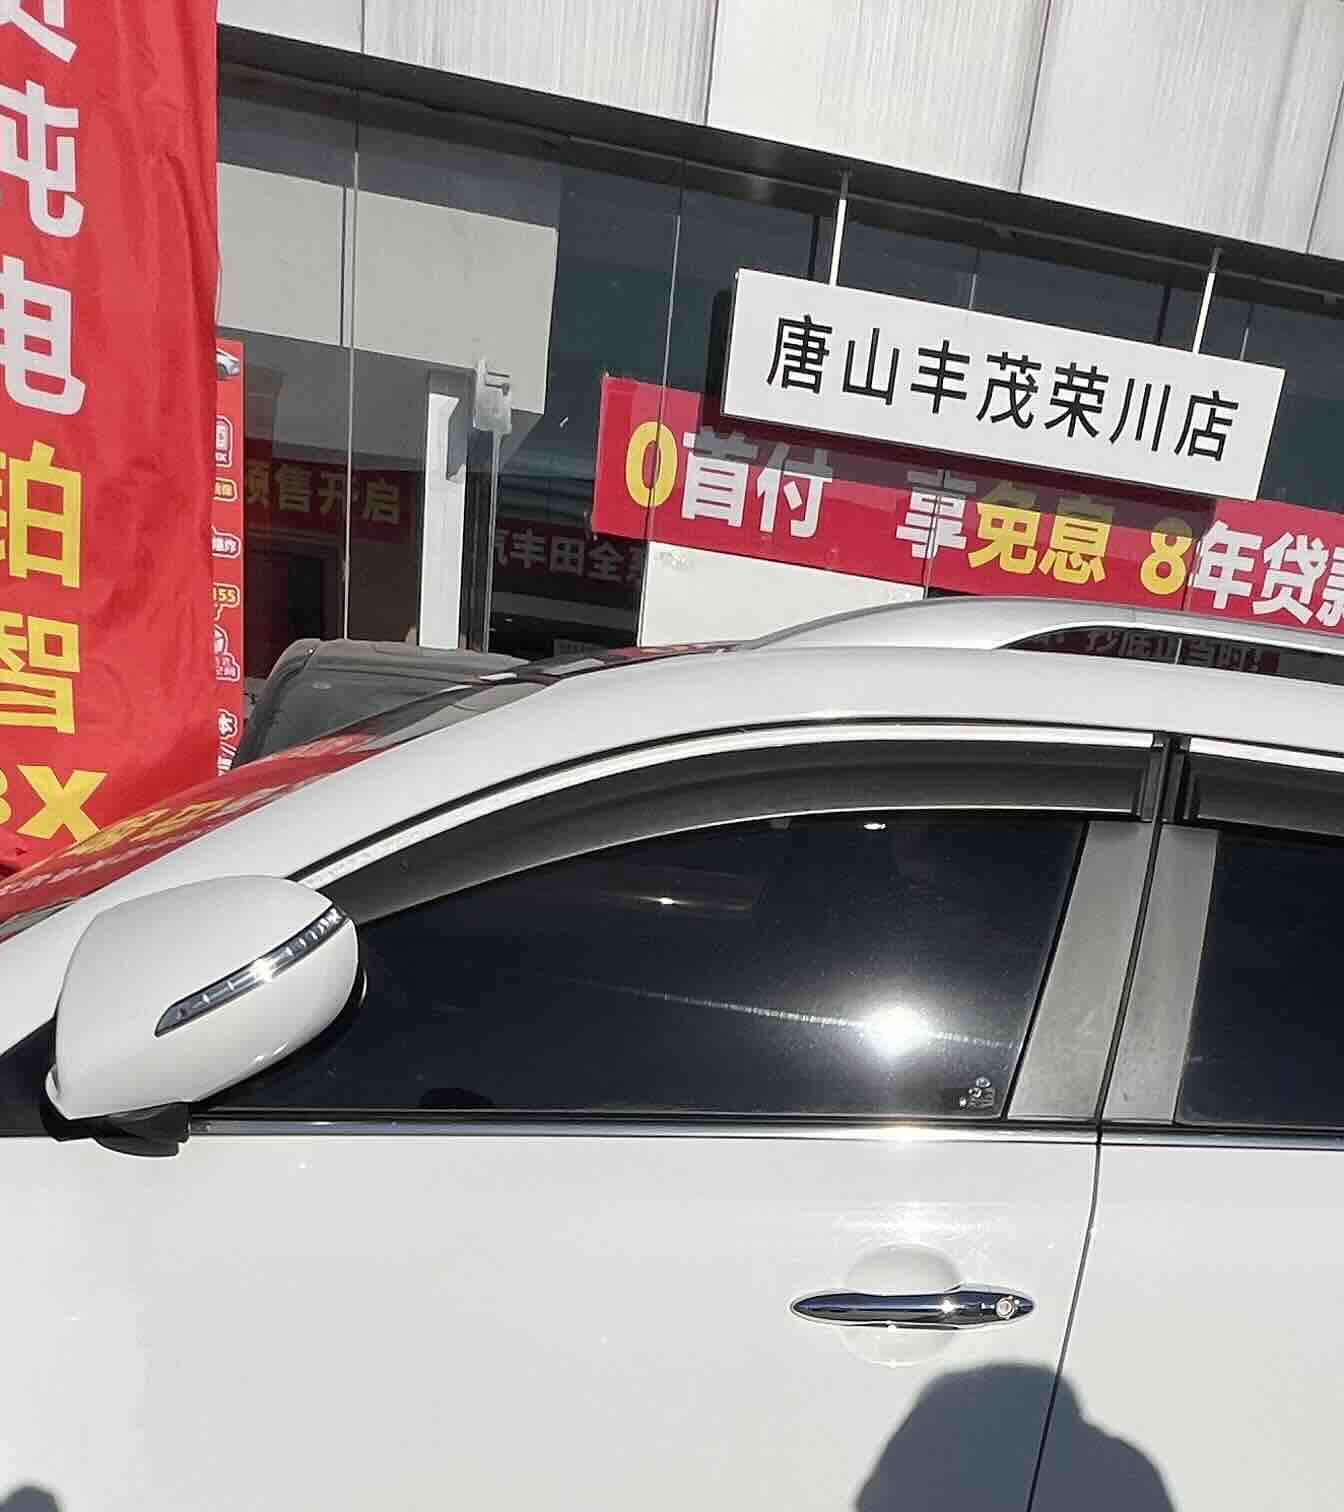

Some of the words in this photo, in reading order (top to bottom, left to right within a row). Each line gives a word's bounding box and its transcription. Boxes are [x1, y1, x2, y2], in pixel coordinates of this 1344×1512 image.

[765, 313, 1241, 464] 唐山丰茂荣川店
[624, 421, 833, 539] 0首付
[896, 466, 1112, 587] 享免息
